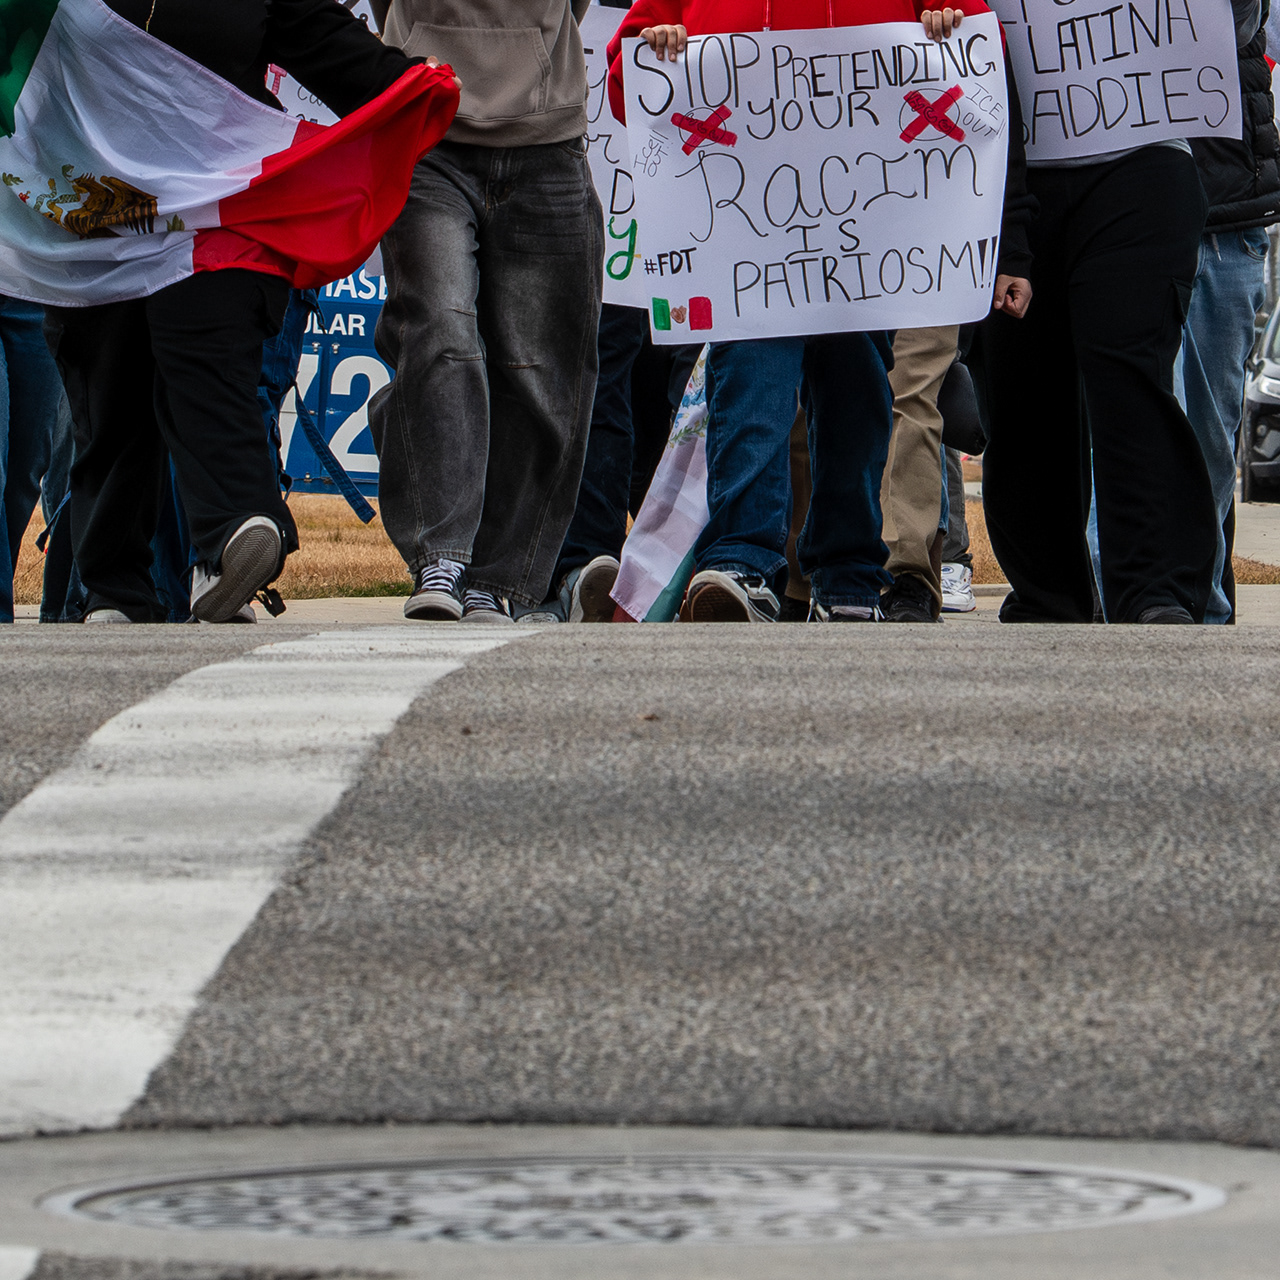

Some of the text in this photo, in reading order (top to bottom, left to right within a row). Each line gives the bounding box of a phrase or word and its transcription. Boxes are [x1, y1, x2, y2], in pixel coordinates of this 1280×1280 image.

[634, 33, 761, 116] STOP
[771, 31, 997, 99] PRETENDING
[965, 82, 1004, 121] ICE
[1023, 65, 1231, 145] ADDIES
[644, 247, 698, 276] #FDT
[784, 219, 862, 261] IS
[732, 234, 999, 318] PATRIOSM!!
